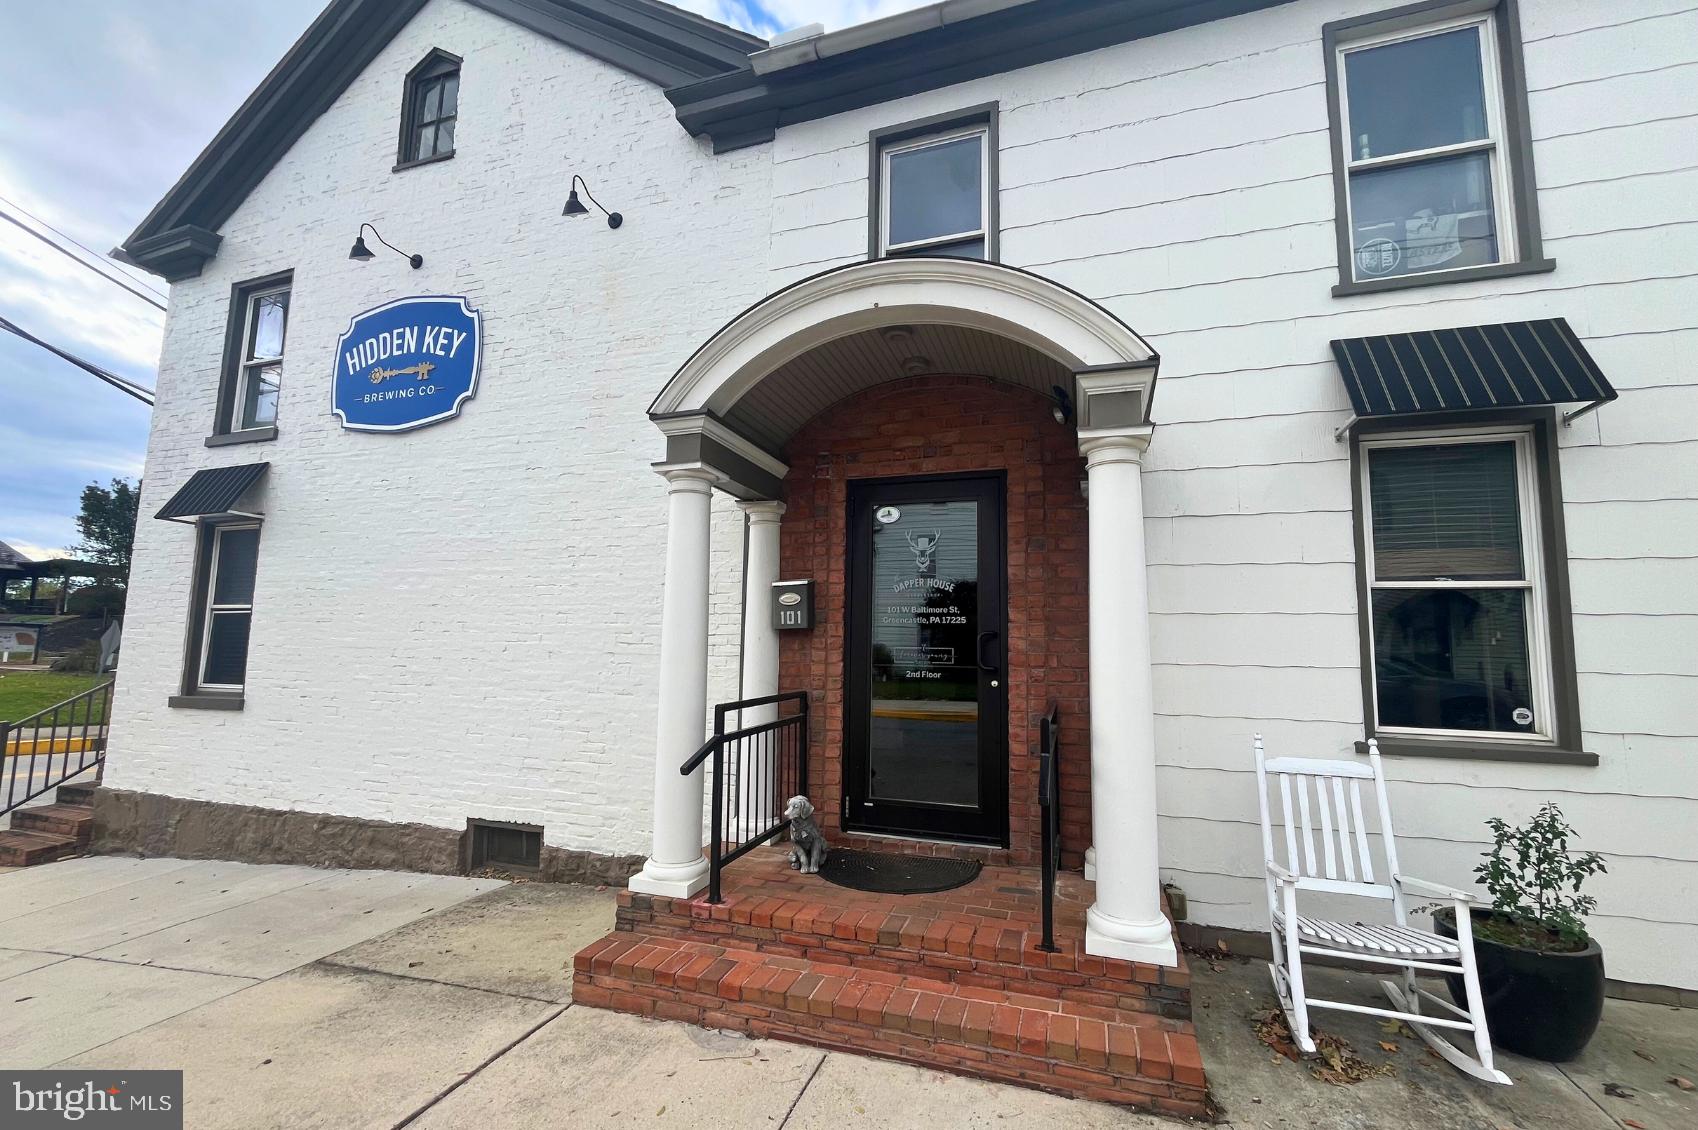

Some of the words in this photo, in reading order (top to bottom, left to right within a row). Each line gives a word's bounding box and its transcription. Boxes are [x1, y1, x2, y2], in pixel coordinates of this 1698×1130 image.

[345, 326, 418, 375] HIDDEN
[422, 325, 467, 358] KEY
[364, 387, 415, 403] BREWING
[893, 578, 925, 593] DAPPER
[927, 578, 956, 593] HOUSE
[780, 610, 801, 625] 101
[887, 606, 900, 614] 101
[902, 606, 910, 614] W
[911, 606, 948, 614] Baltimore
[949, 605, 960, 615] St,
[882, 616, 929, 625] Greencastle,
[929, 616, 941, 624] PA
[941, 616, 967, 624] 17225
[905, 670, 920, 679] 2nd
[921, 670, 942, 679] Floor
